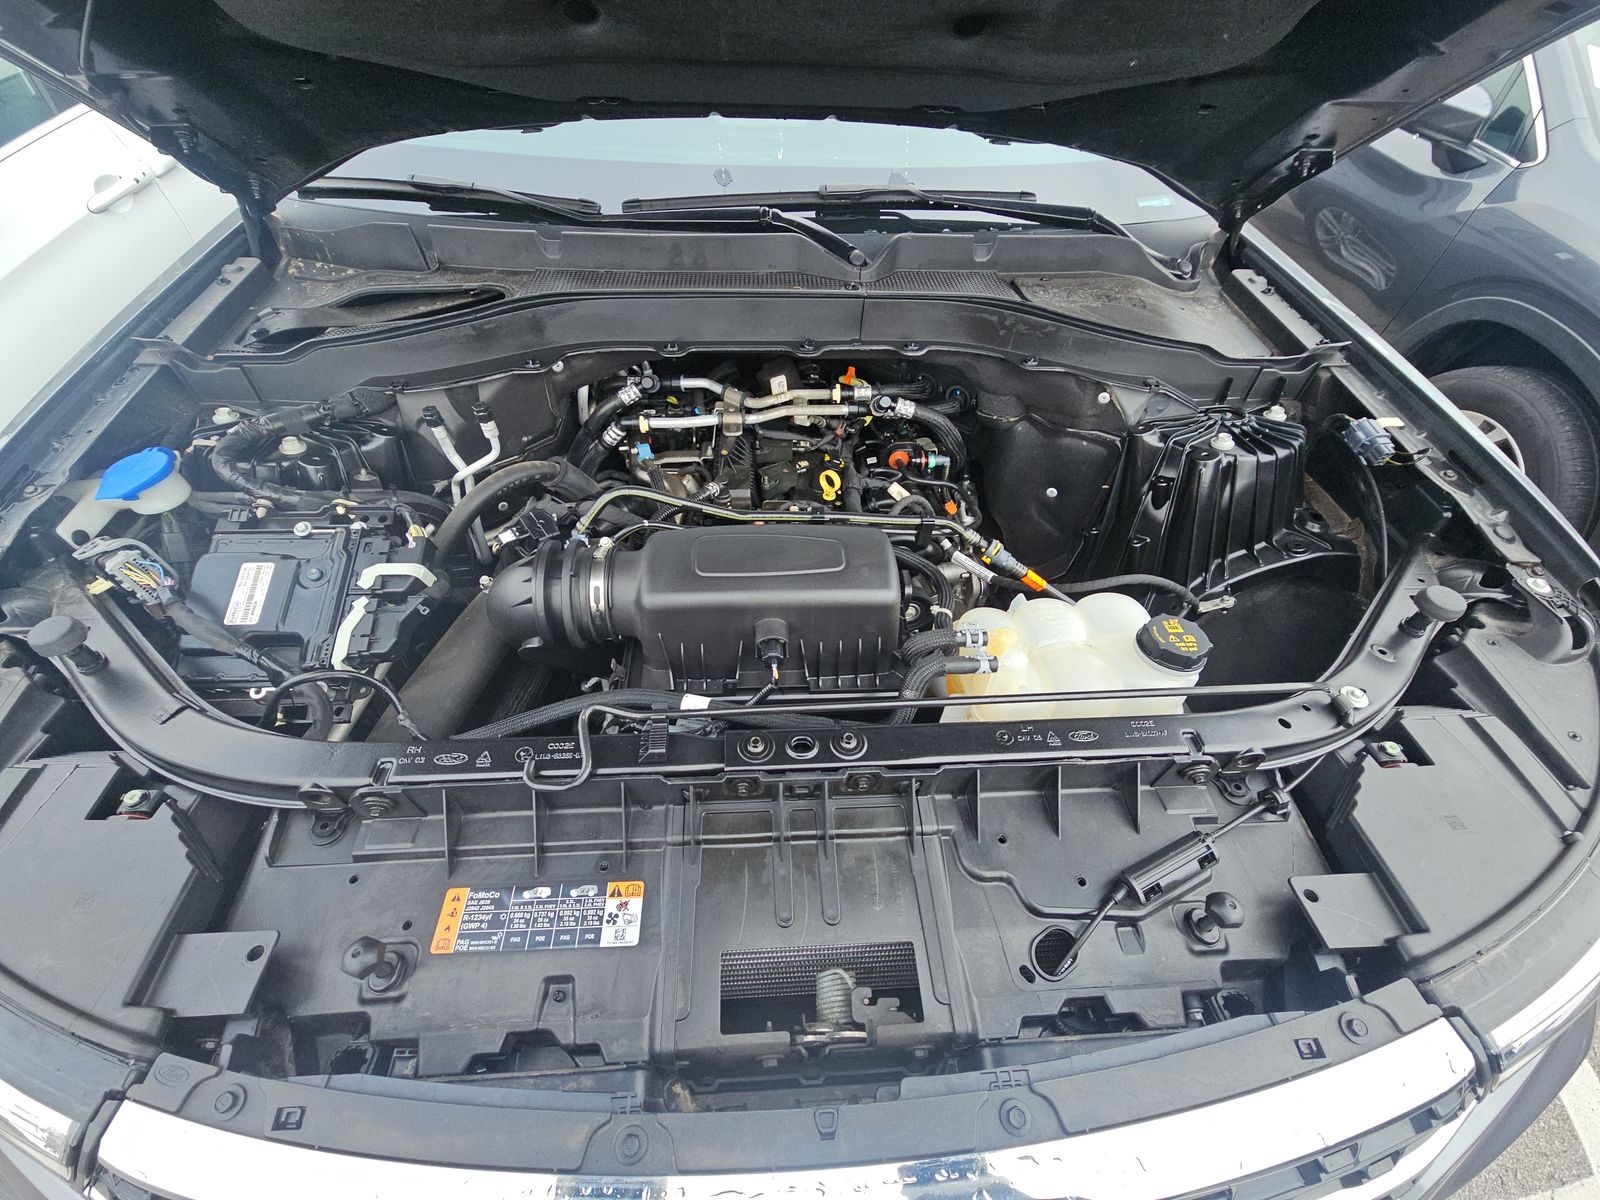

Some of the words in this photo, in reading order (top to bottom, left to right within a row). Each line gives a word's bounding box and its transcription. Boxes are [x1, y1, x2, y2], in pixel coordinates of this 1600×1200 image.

[1021, 724, 1034, 732] LH
[1069, 730, 1098, 742] Ford
[406, 746, 422, 754] RH
